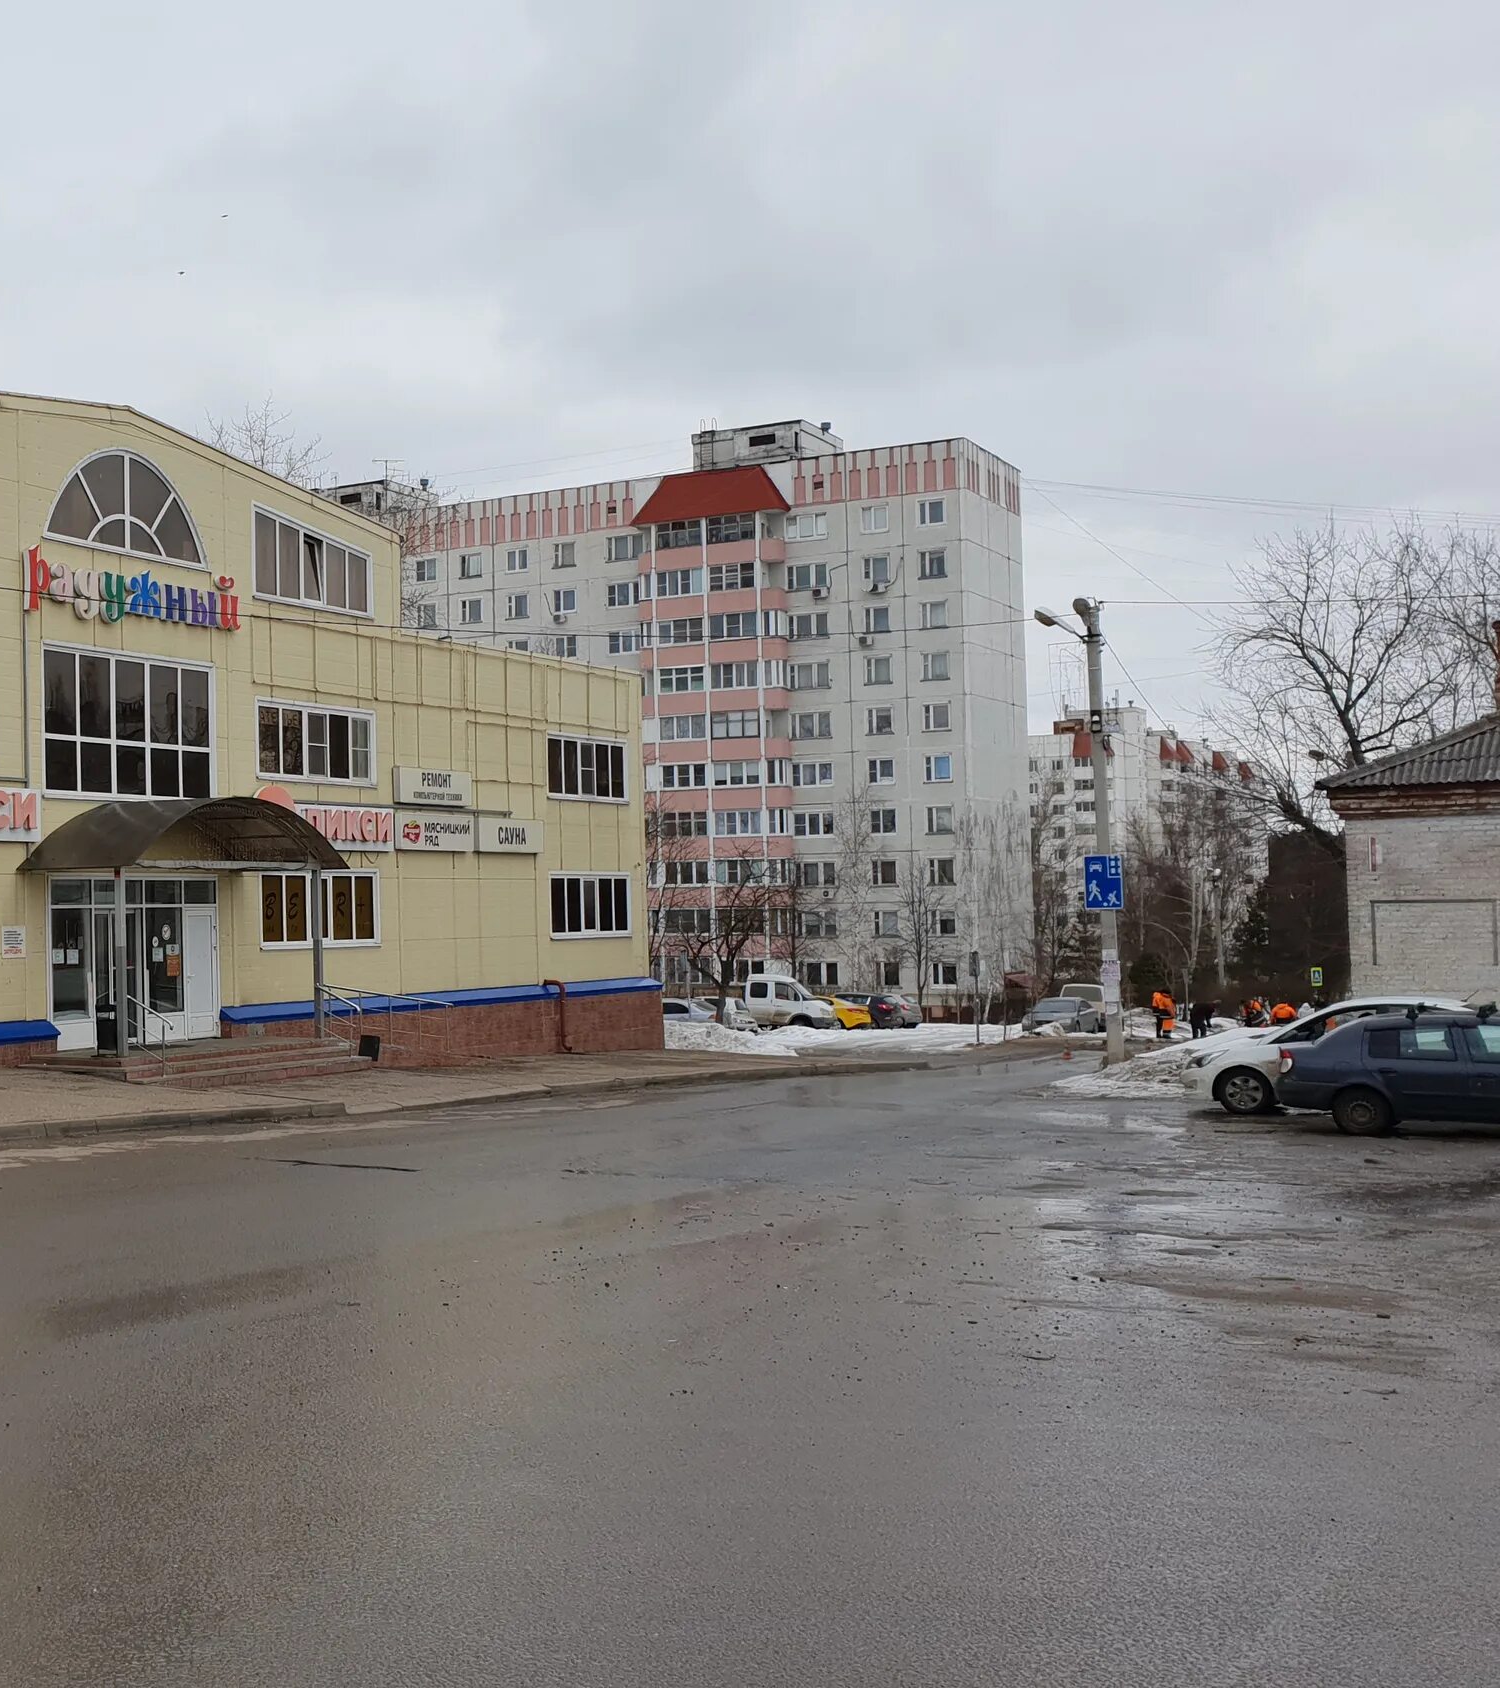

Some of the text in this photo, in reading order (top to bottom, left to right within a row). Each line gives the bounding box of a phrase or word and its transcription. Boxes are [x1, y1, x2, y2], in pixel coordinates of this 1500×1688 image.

[421, 772, 452, 789] РЕМОНТ
[424, 820, 471, 835] МЯСНИЦКИЙ
[424, 834, 440, 847] РЯД
[497, 826, 527, 846] САУНА
